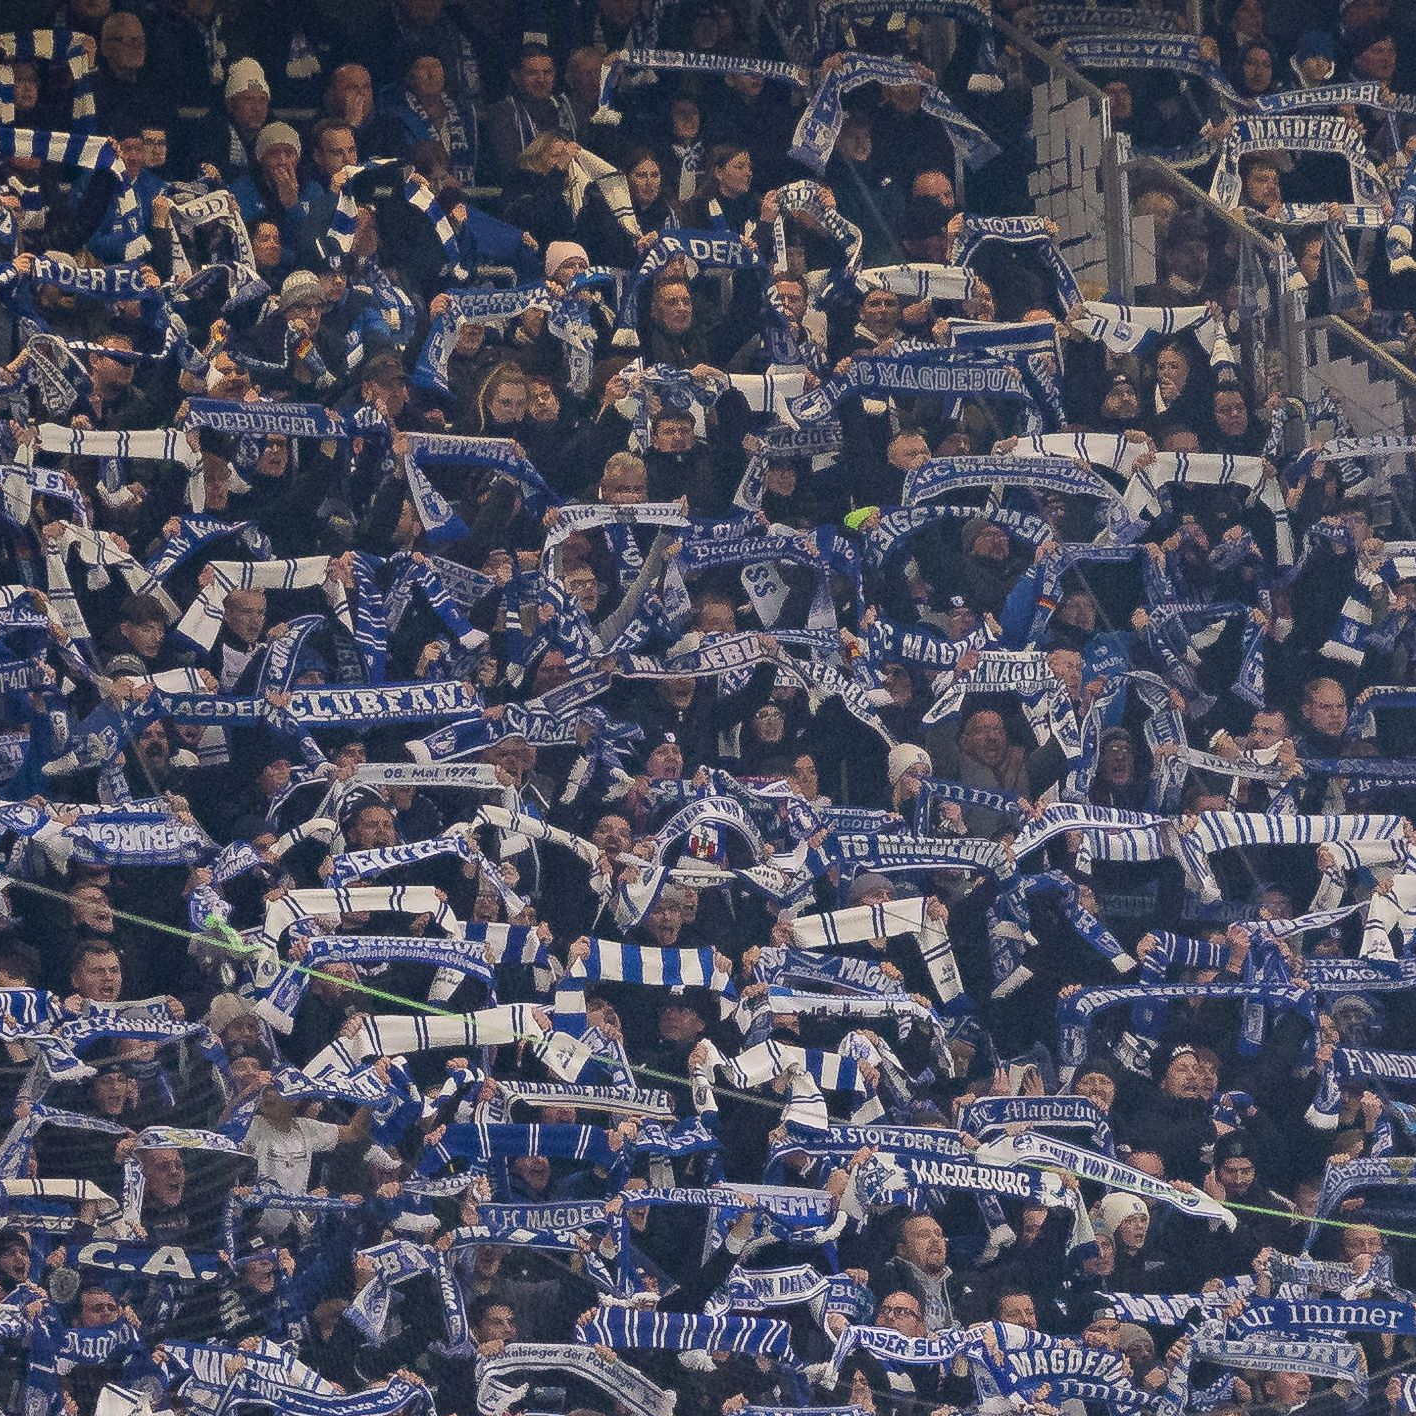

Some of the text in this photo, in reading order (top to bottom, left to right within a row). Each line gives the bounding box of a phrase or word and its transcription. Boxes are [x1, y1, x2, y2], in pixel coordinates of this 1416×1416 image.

[689, 240, 743, 264] DER
[59, 265, 106, 289] DER
[384, 767, 405, 780] 08.
[444, 766, 478, 781] 1974
[847, 1128, 899, 1150] STOLZ
[903, 1132, 932, 1154] DER
[911, 1159, 1030, 1197] MAGDEBURG
[1081, 1151, 1136, 1189] VON DER
[502, 1209, 524, 1230] FC
[1287, 1304, 1401, 1328] immer
